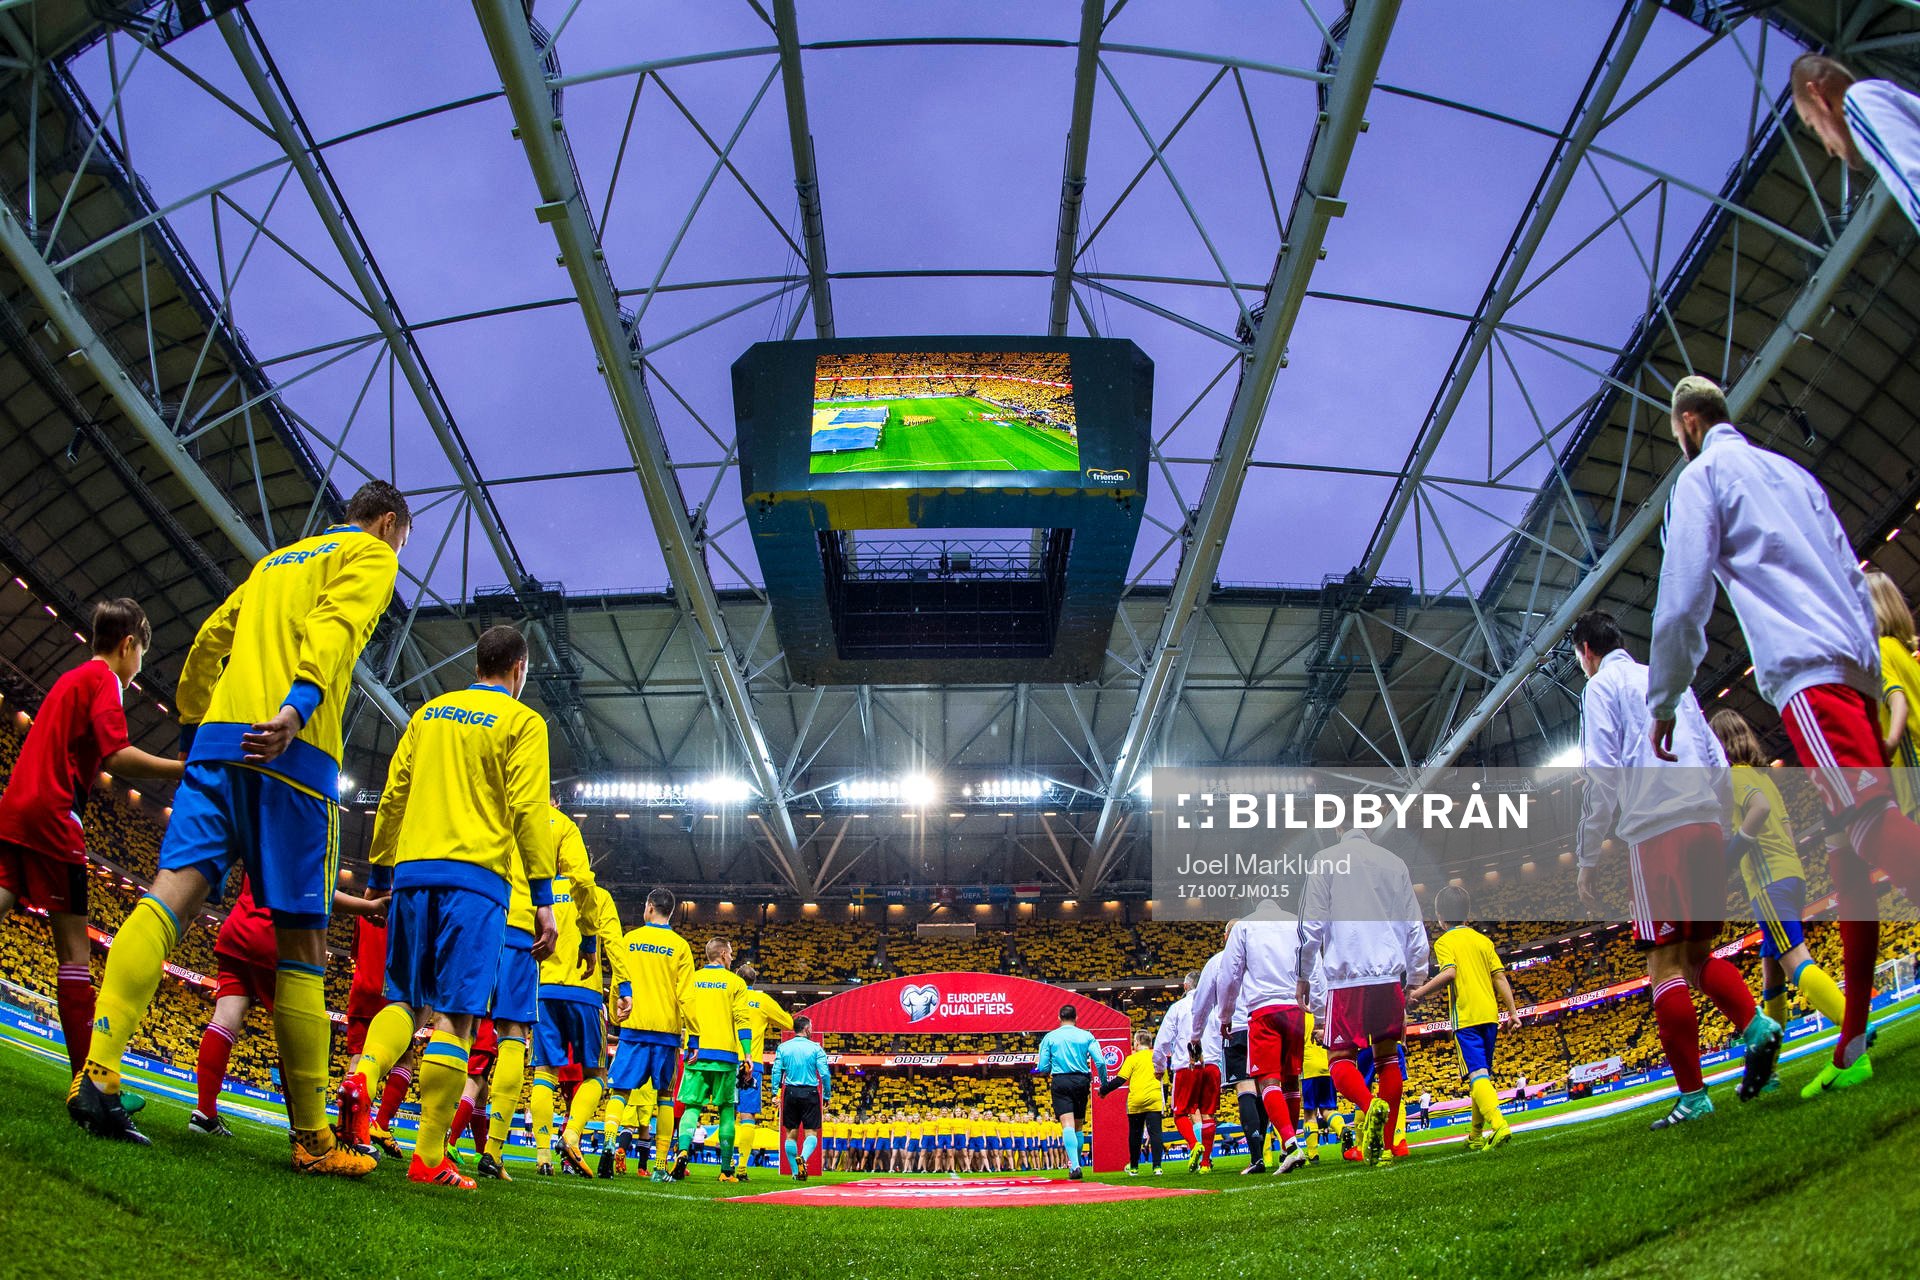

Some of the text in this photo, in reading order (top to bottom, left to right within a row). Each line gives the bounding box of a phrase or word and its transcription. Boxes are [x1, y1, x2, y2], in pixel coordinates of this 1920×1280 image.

[1093, 472, 1124, 481] friends
[262, 542, 340, 572] SVERGE
[423, 706, 499, 728] SVERIGE
[629, 943, 675, 957] SVERIGE
[947, 992, 1006, 1003] EUROPEAN
[1568, 989, 1606, 1006] ODDSET
[940, 1003, 1014, 1017] QUALIFIERS
[1498, 1007, 1536, 1020] DSET
[1427, 1020, 1452, 1031] ODDS
[894, 1055, 945, 1064] ODDSET
[987, 1055, 1037, 1063] ODDSET
